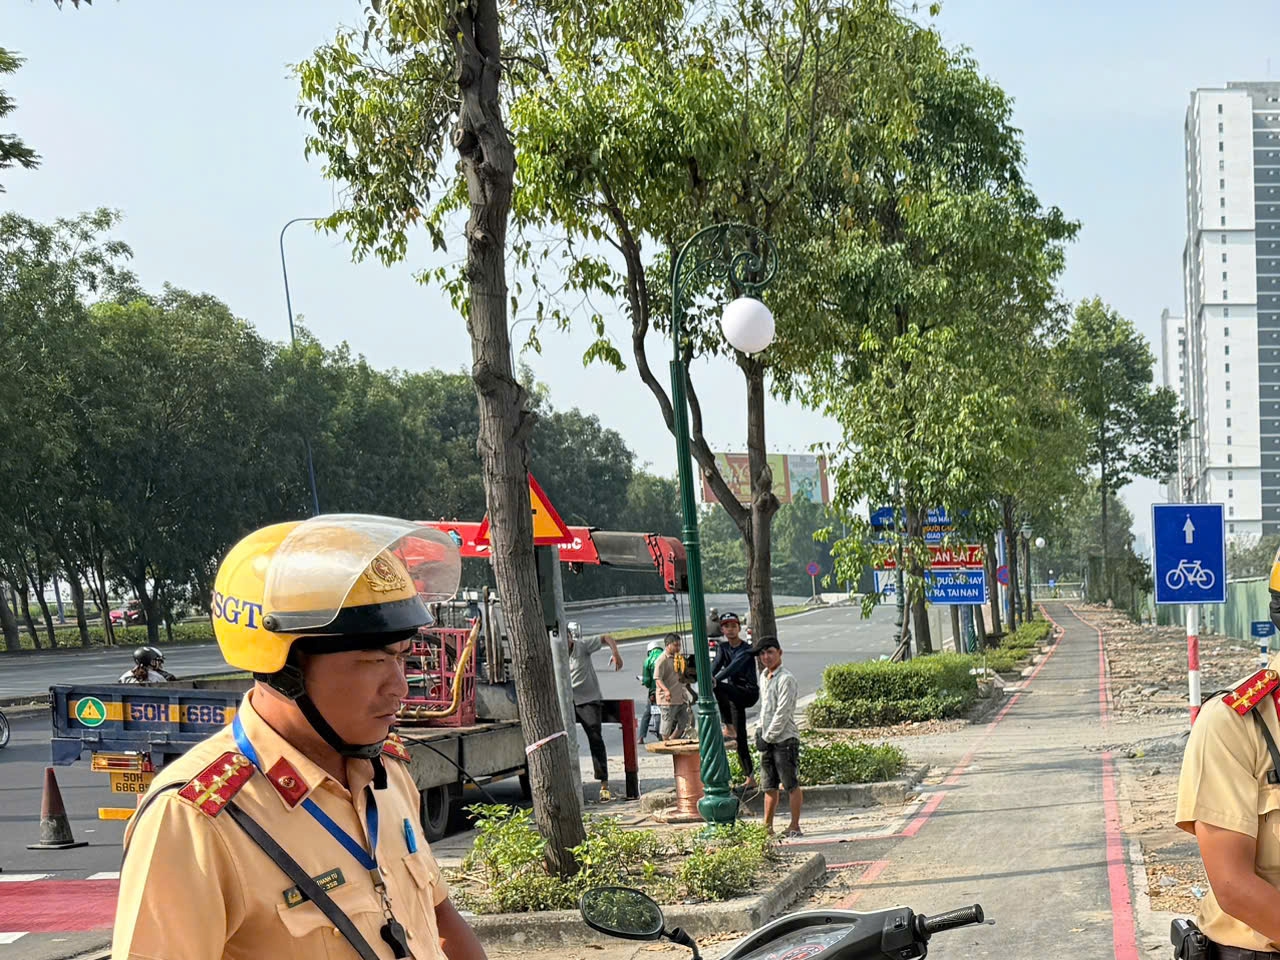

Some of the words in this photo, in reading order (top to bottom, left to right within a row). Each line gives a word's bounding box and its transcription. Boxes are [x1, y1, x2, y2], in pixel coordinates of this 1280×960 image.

[948, 589, 960, 597] TAI
[212, 590, 262, 629] SGT
[130, 702, 169, 721] 50H
[123, 772, 144, 782] 50H
